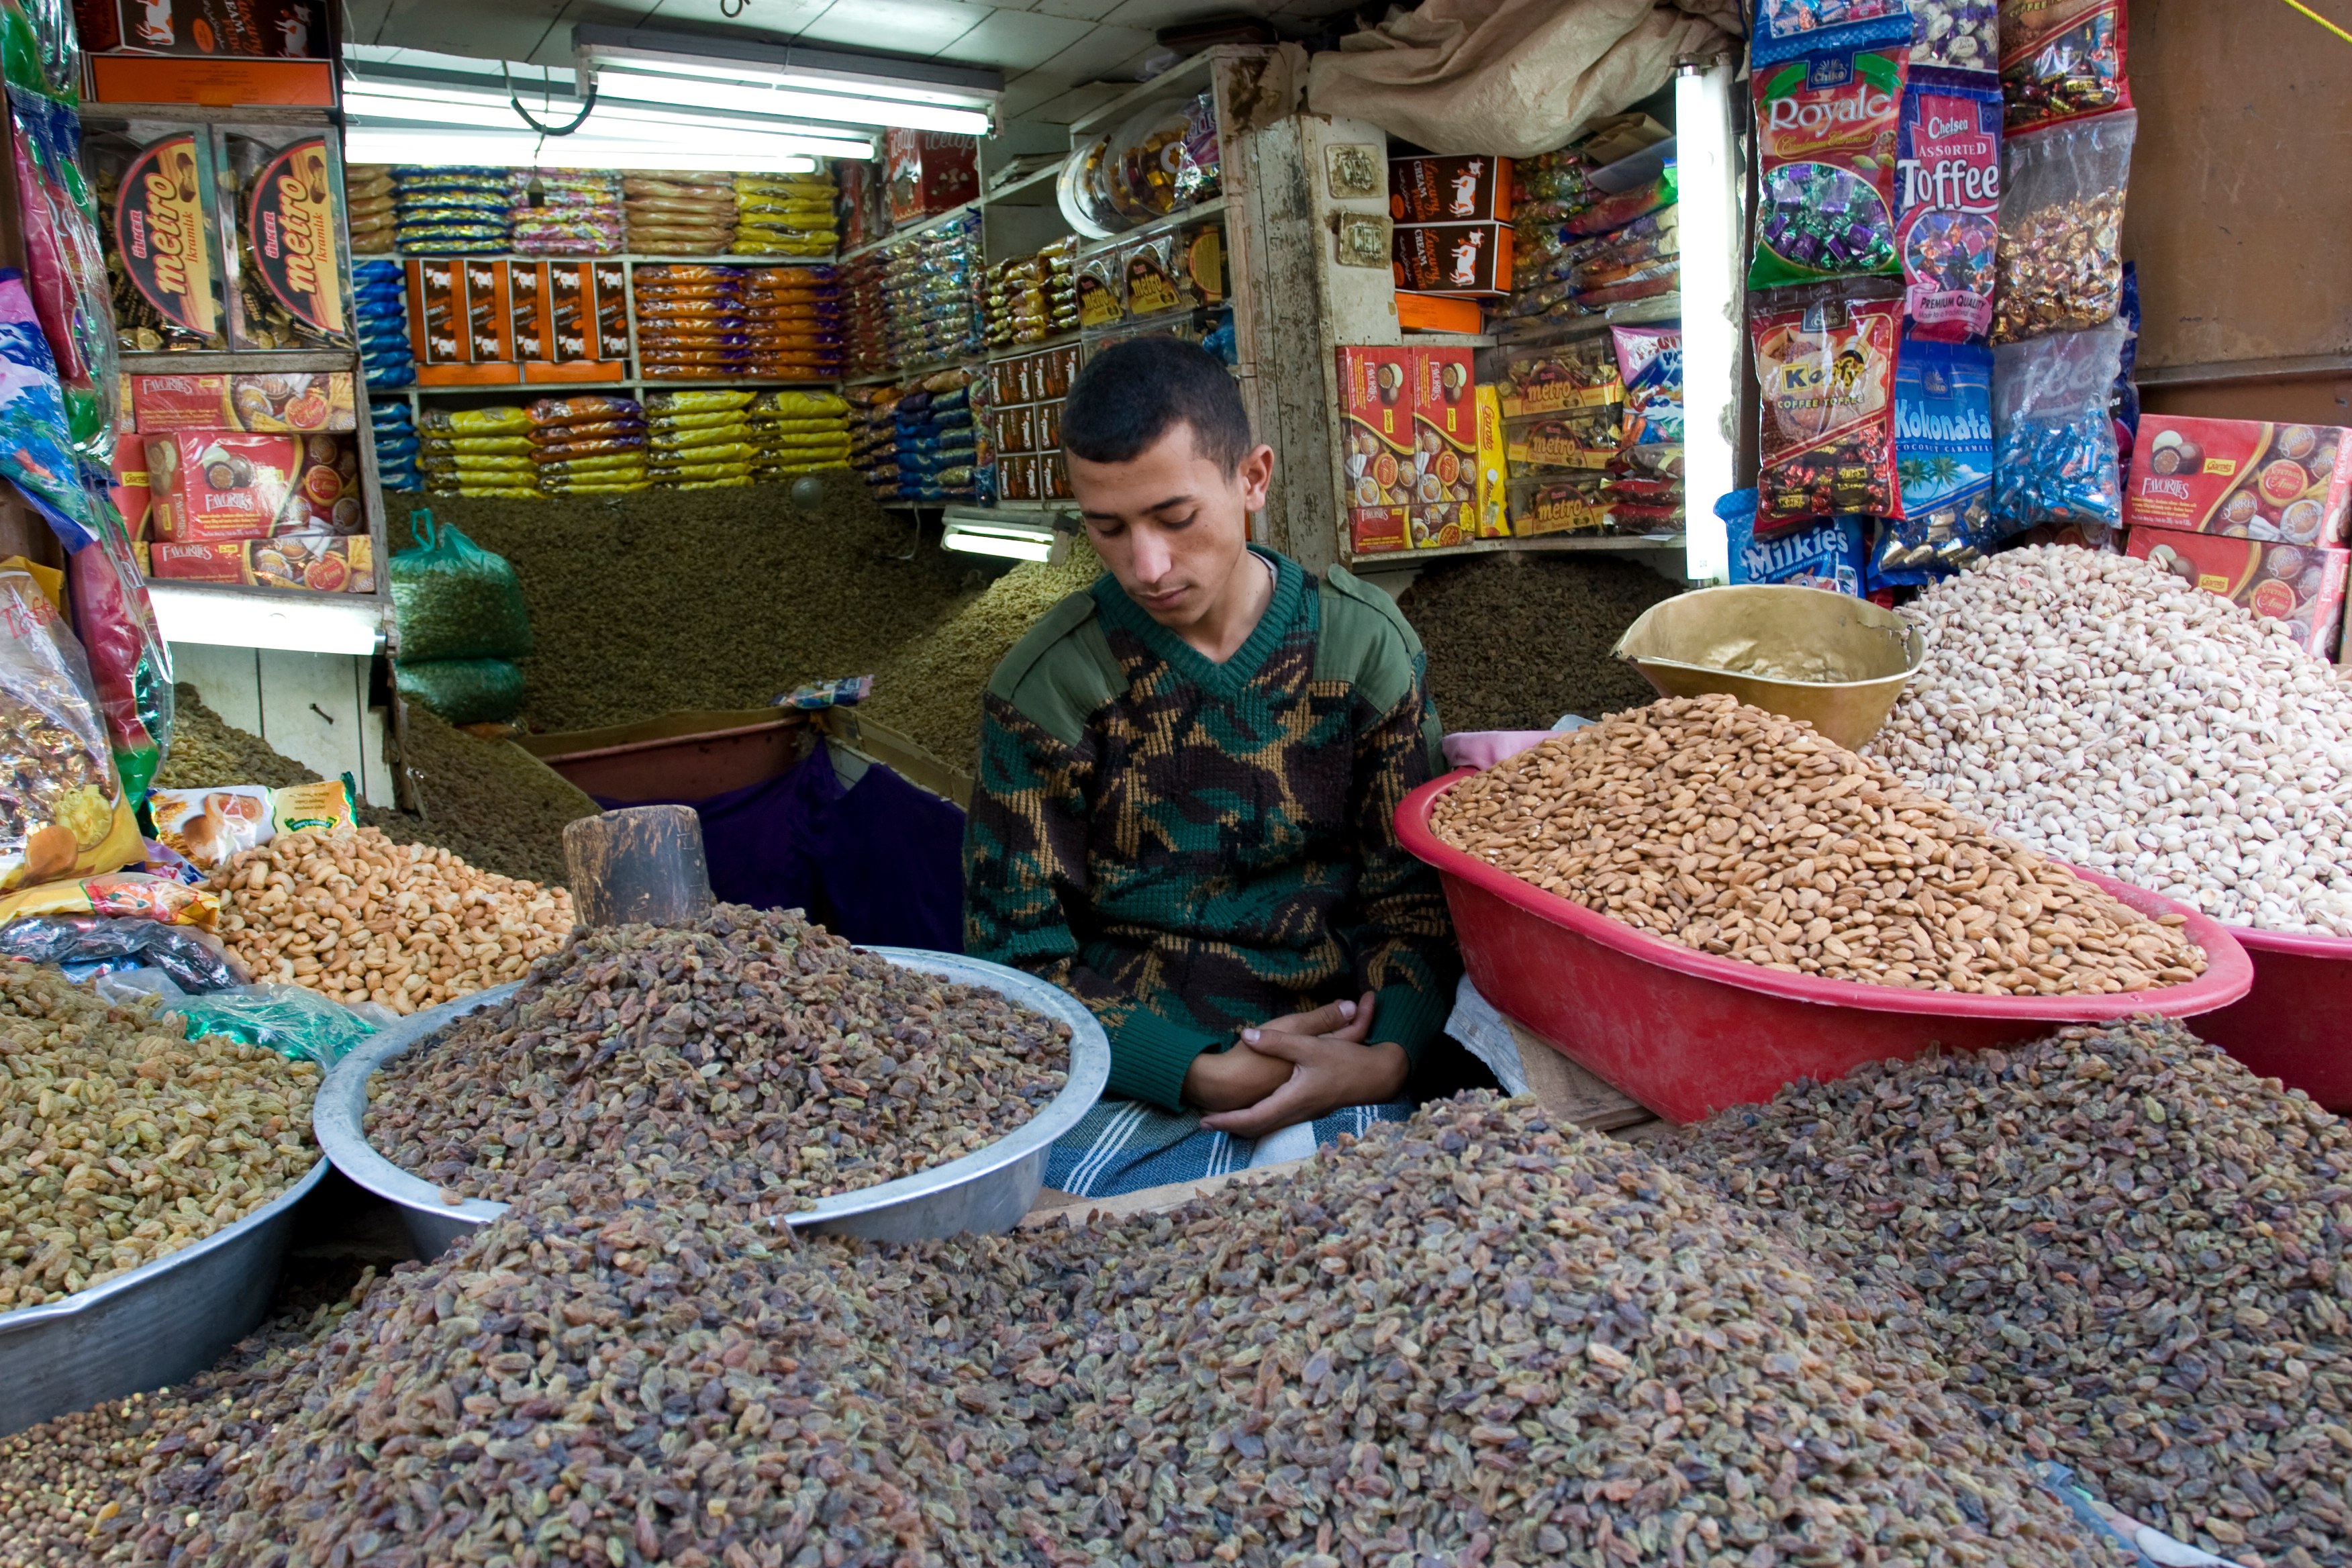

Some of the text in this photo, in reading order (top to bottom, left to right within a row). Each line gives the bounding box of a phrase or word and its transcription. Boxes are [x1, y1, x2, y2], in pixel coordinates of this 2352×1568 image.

[1769, 83, 1892, 138] Royale
[1928, 117, 1969, 140] Chelsea
[1919, 142, 1987, 158] ASSORTED
[1414, 160, 1428, 199] CREAM
[1896, 159, 2000, 209] Toffee
[130, 209, 148, 259] ÜLKER
[144, 173, 187, 295] metro
[262, 211, 279, 259] ÜLKER
[277, 175, 317, 294] metro
[1414, 229, 1428, 267] CREAM
[1920, 294, 1987, 311] PREMIUM QUALITY
[142, 378, 193, 395] FAVORITES
[1364, 362, 1377, 402] FAVORITES
[1429, 362, 1442, 401] FAVORITES
[1526, 381, 1571, 403] metro
[1778, 395, 1865, 409] COFFEE TOFFEE
[1895, 398, 1992, 441] Kokonata
[1481, 404, 1495, 451] Garoto
[1532, 436, 1577, 456] metro
[1896, 444, 1939, 453] COCONUT
[205, 493, 253, 512] FAVORITES
[2141, 477, 2190, 500] FAVORITES
[172, 493, 187, 538] FAVORITES
[1538, 499, 1583, 522] metro
[162, 544, 213, 562] FAVORITES
[1744, 526, 1849, 579] Milkies
